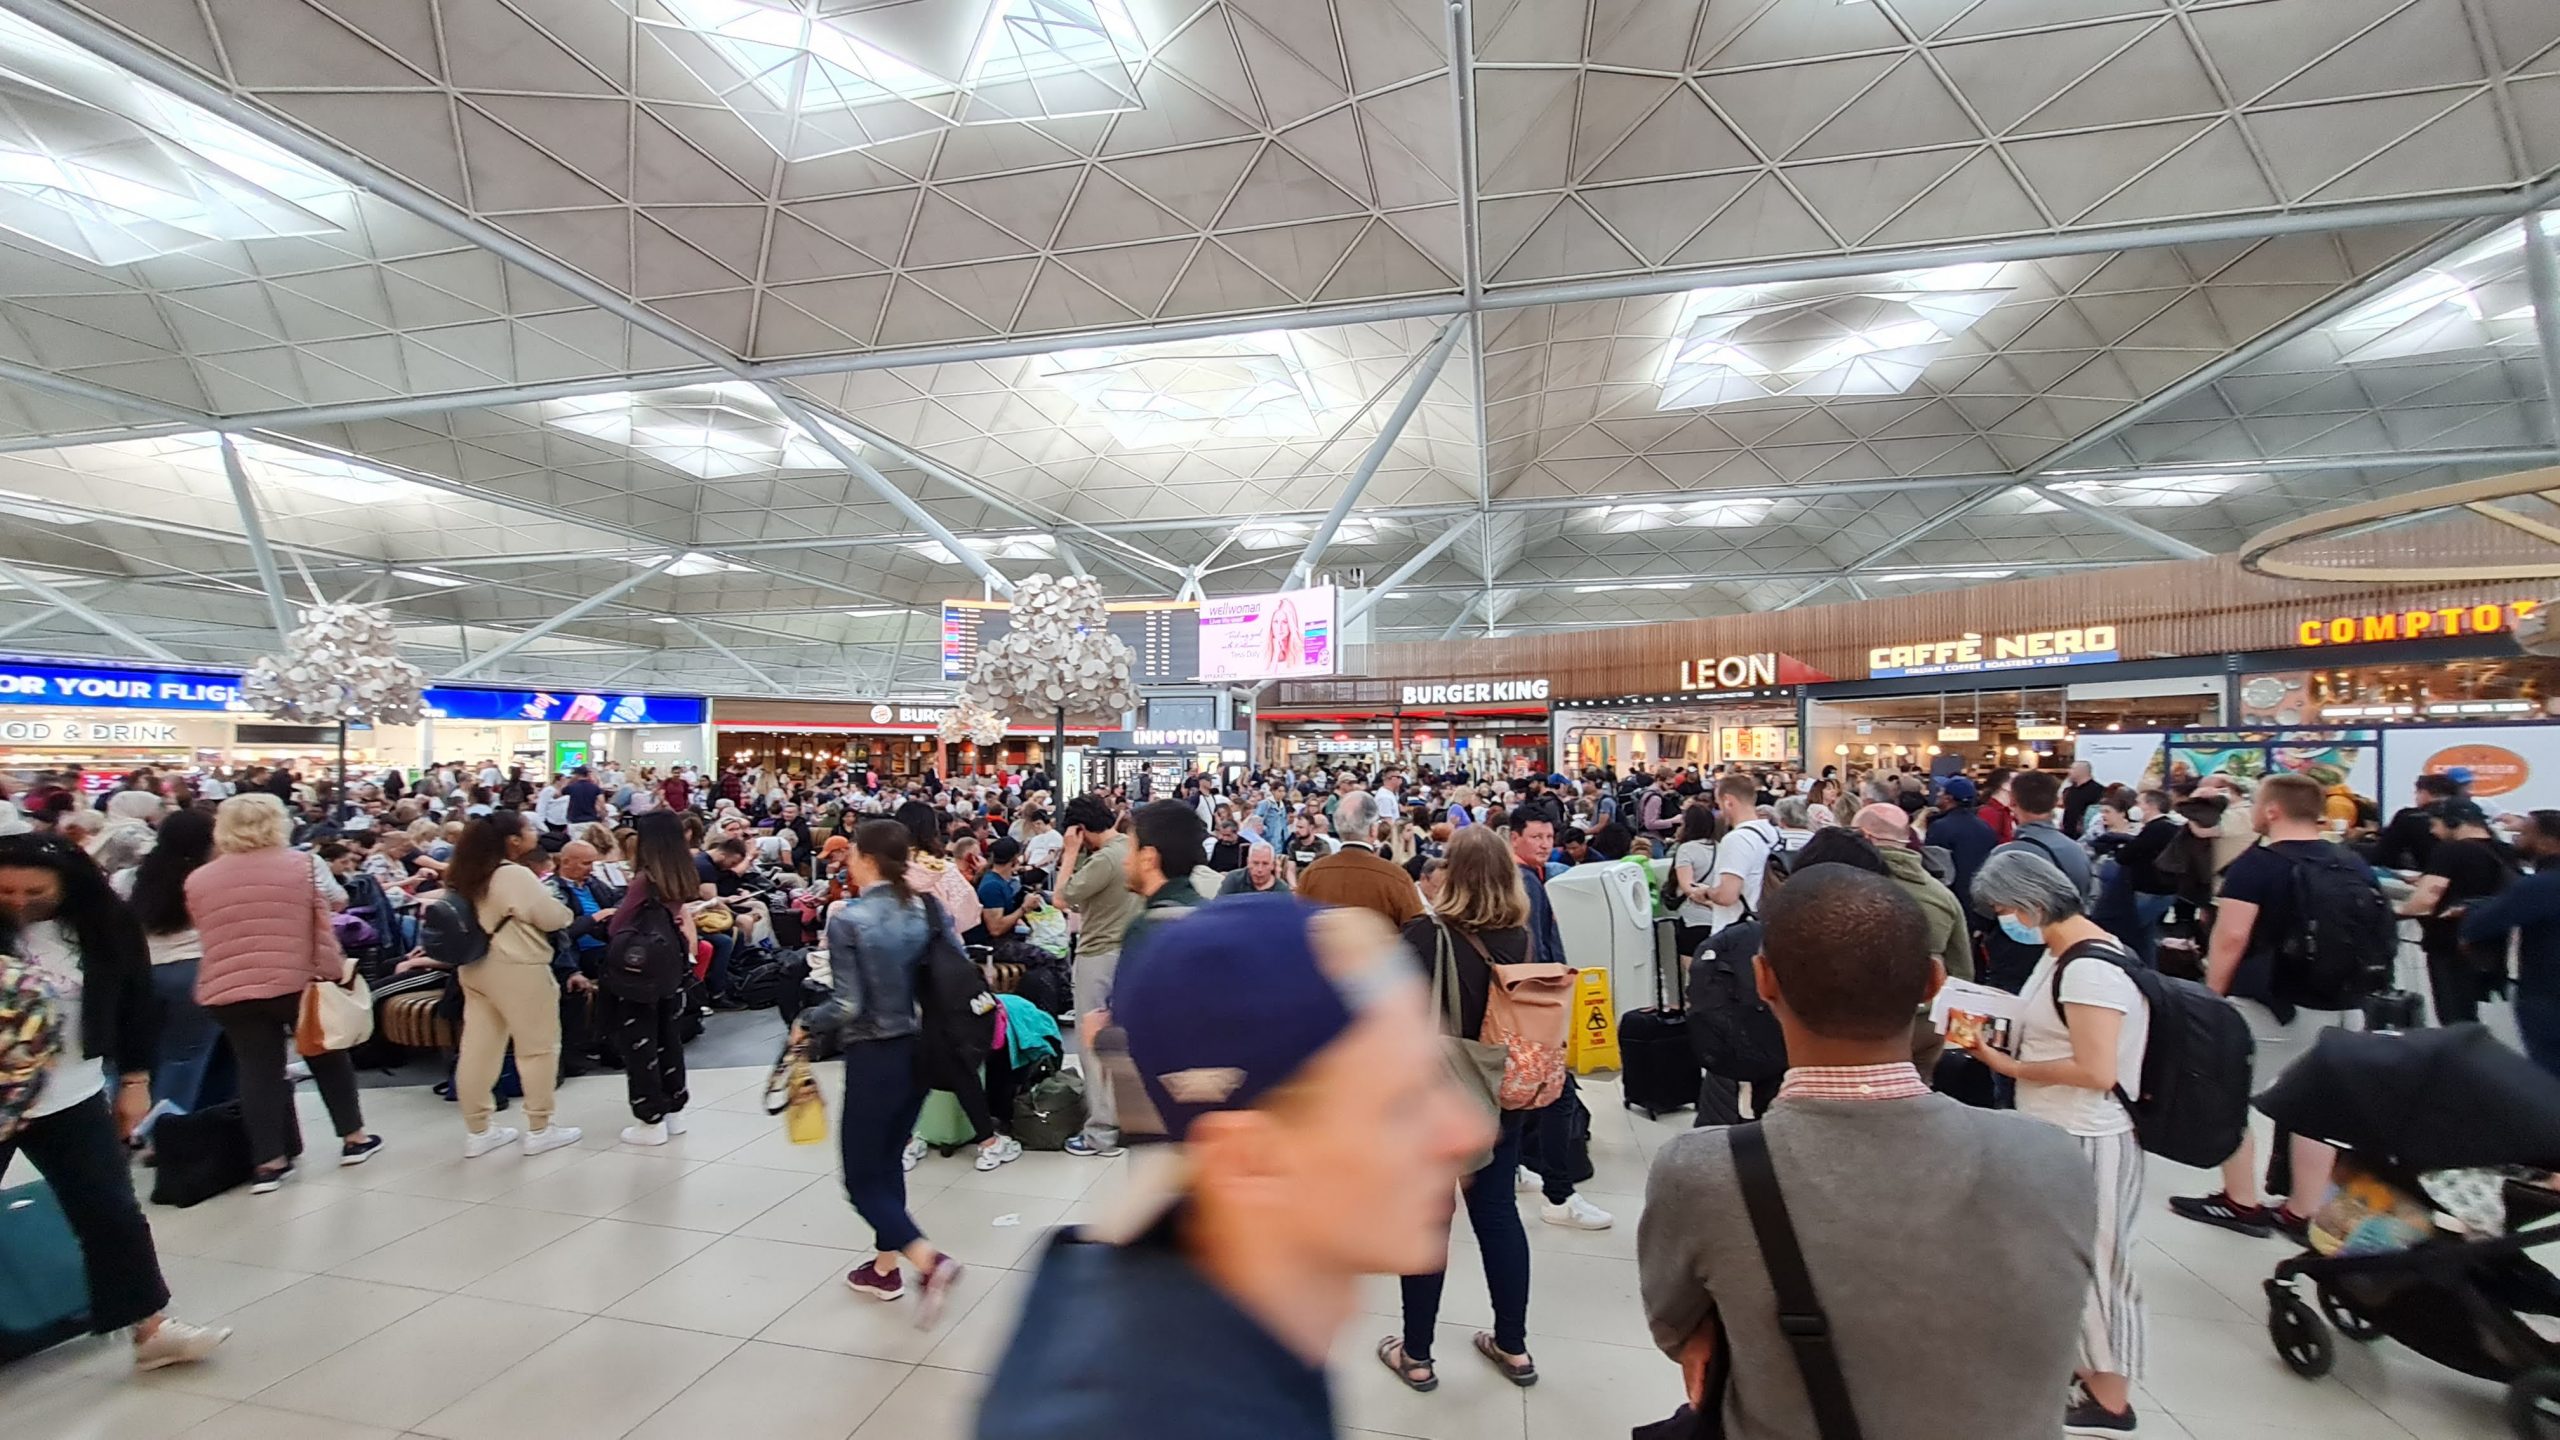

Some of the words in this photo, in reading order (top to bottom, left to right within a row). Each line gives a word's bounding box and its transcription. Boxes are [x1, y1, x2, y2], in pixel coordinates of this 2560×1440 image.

[1209, 602, 1261, 617] wellwoman
[1870, 632, 1982, 669] CAFFÈ
[1996, 626, 2116, 659] NERO
[1681, 652, 1777, 690] LEON
[1945, 662, 1982, 672] COFFEE
[1985, 658, 2034, 669] ROASTERS
[2045, 656, 2070, 665] DELI
[54, 677, 151, 699] YOUR
[1402, 683, 1490, 704] BURGER
[1491, 679, 1549, 701] KING
[899, 707, 946, 723] BURG
[64, 724, 81, 739] &
[93, 724, 178, 741] DRINK
[1133, 729, 1219, 745] INMOTION
